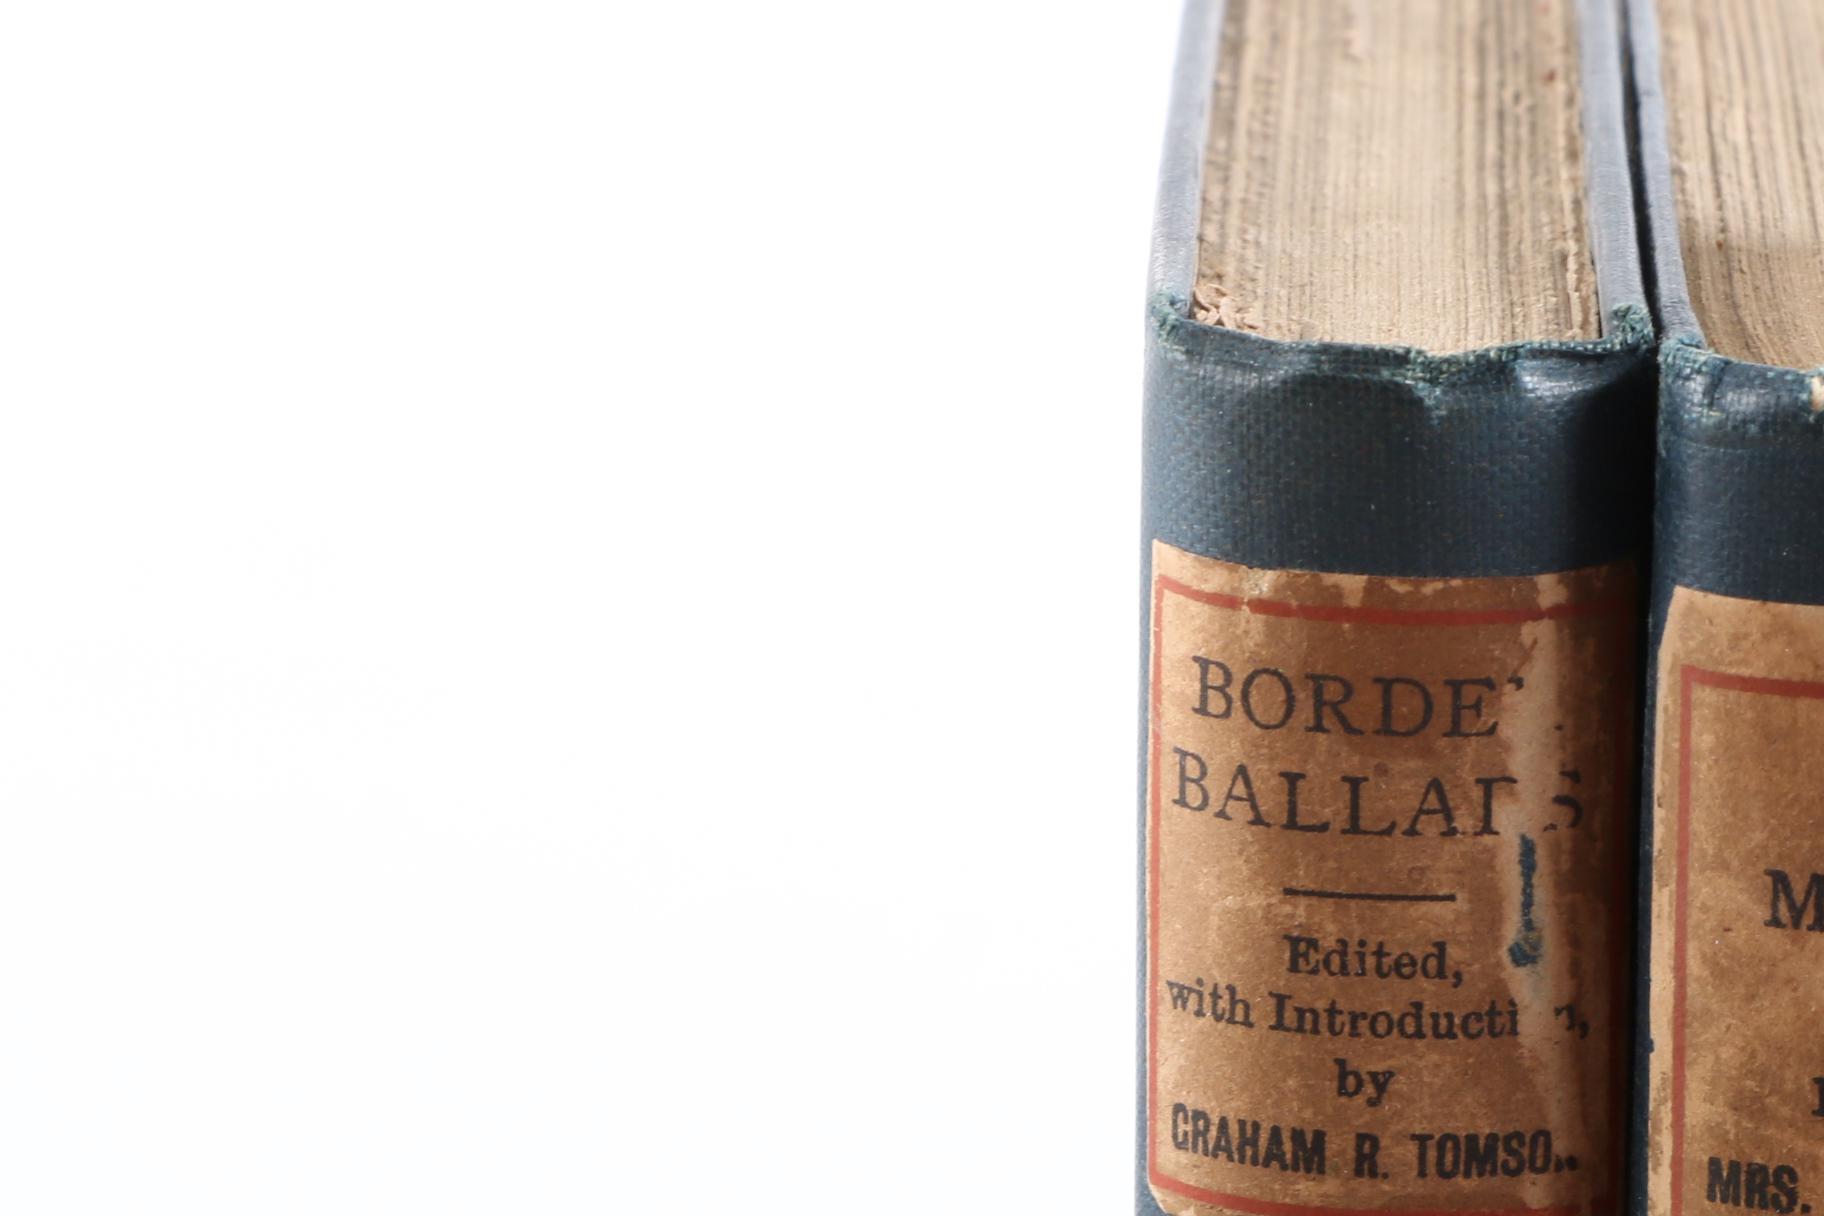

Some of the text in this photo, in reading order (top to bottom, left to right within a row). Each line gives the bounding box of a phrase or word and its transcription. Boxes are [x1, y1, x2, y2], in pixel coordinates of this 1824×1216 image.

[1191, 655, 1563, 739] BORDE
[1284, 935, 1463, 989] Edited,
[1166, 977, 1590, 1041] with Introductin,
[1334, 1059, 1396, 1108] by
[1171, 1102, 1327, 1176] GRAHAM
[1356, 1131, 1390, 1179] R.
[1707, 1157, 1811, 1216] MRS.
